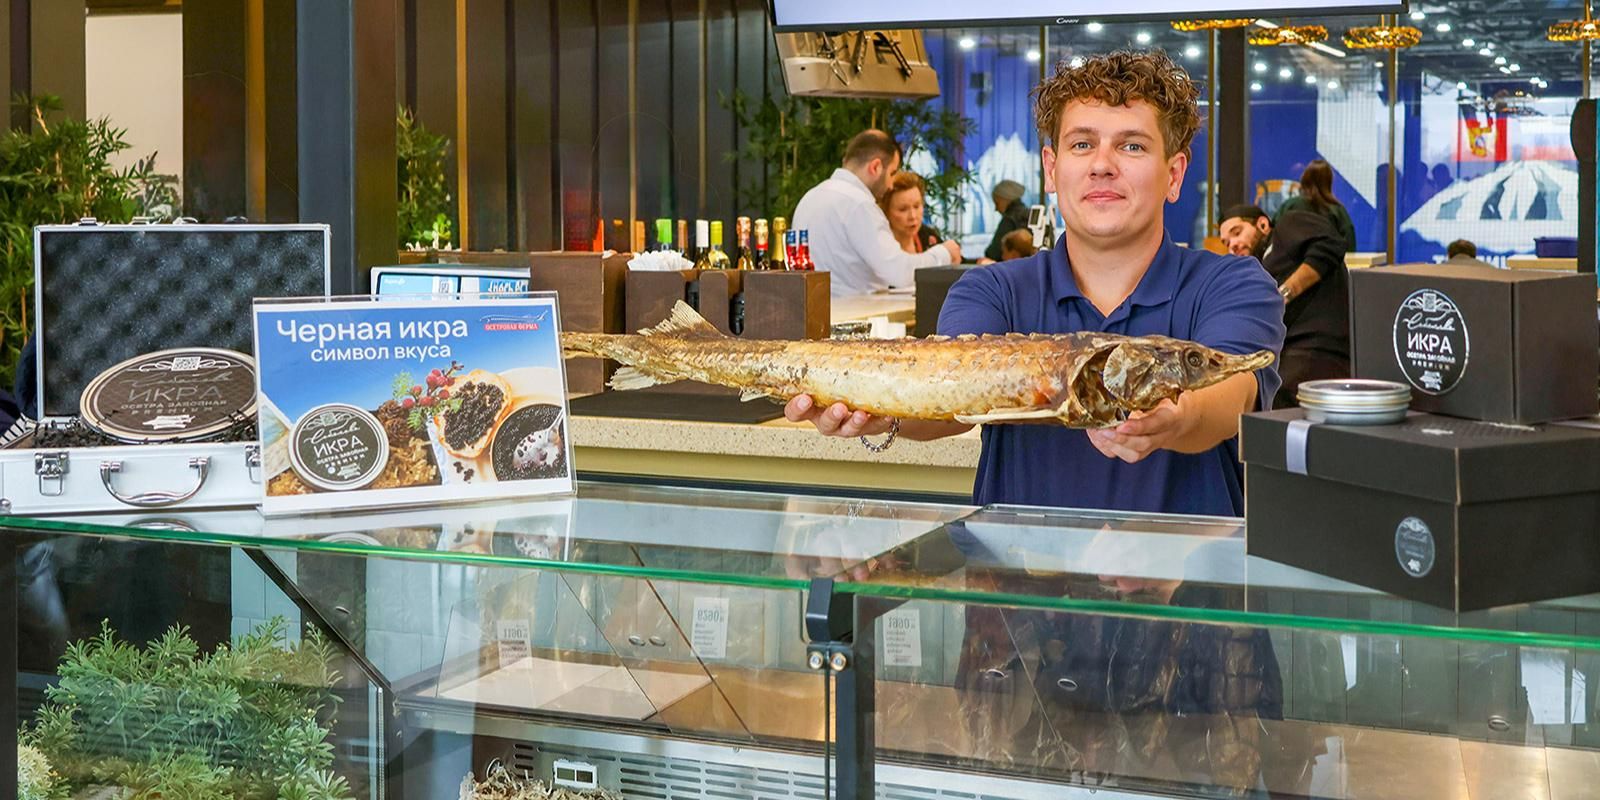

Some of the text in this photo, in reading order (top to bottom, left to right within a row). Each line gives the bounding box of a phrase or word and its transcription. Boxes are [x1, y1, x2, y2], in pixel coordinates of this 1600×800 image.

[277, 318, 468, 348] Черная икра
[1407, 332, 1453, 354] ИКРА
[311, 343, 451, 363] символ вкуса
[128, 386, 222, 402] ИКРА
[131, 407, 213, 415] PREMIUM
[313, 435, 364, 458] ИКРА
